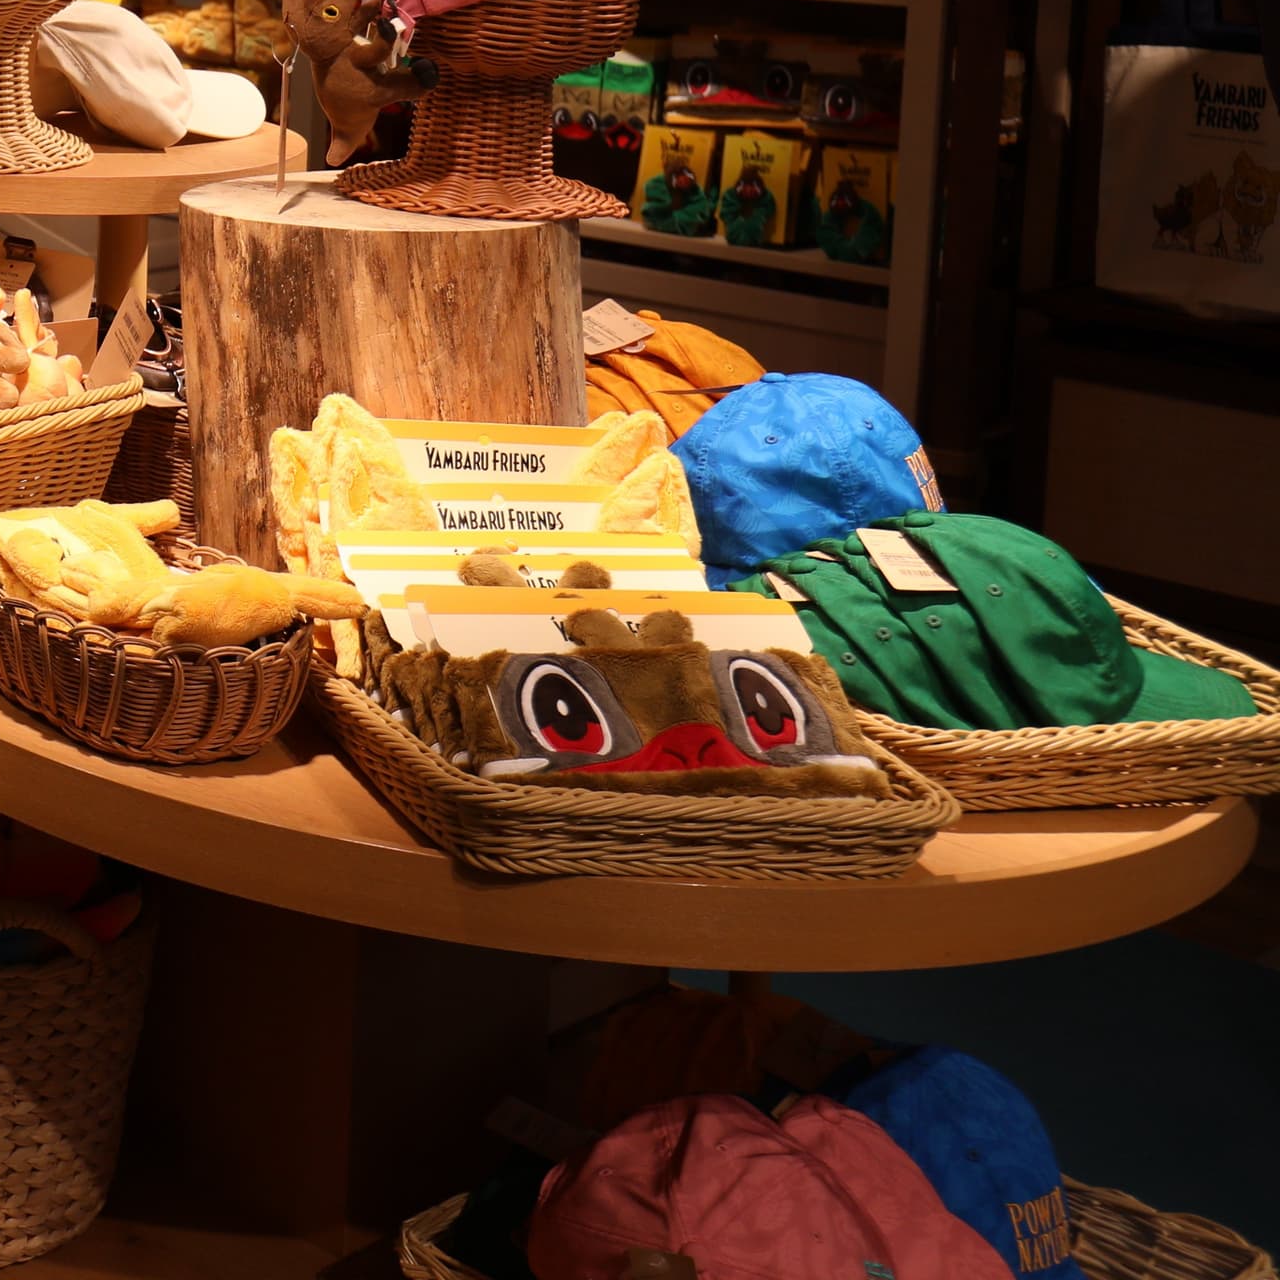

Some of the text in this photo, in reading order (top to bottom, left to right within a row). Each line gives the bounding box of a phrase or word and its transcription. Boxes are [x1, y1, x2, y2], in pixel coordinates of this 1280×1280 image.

[1193, 72, 1266, 109] YAMBARU
[1196, 101, 1259, 132] FRIENDS
[425, 441, 546, 473] YAMBARU FRIENDS
[437, 502, 565, 531] YAMBARU FRIENDS
